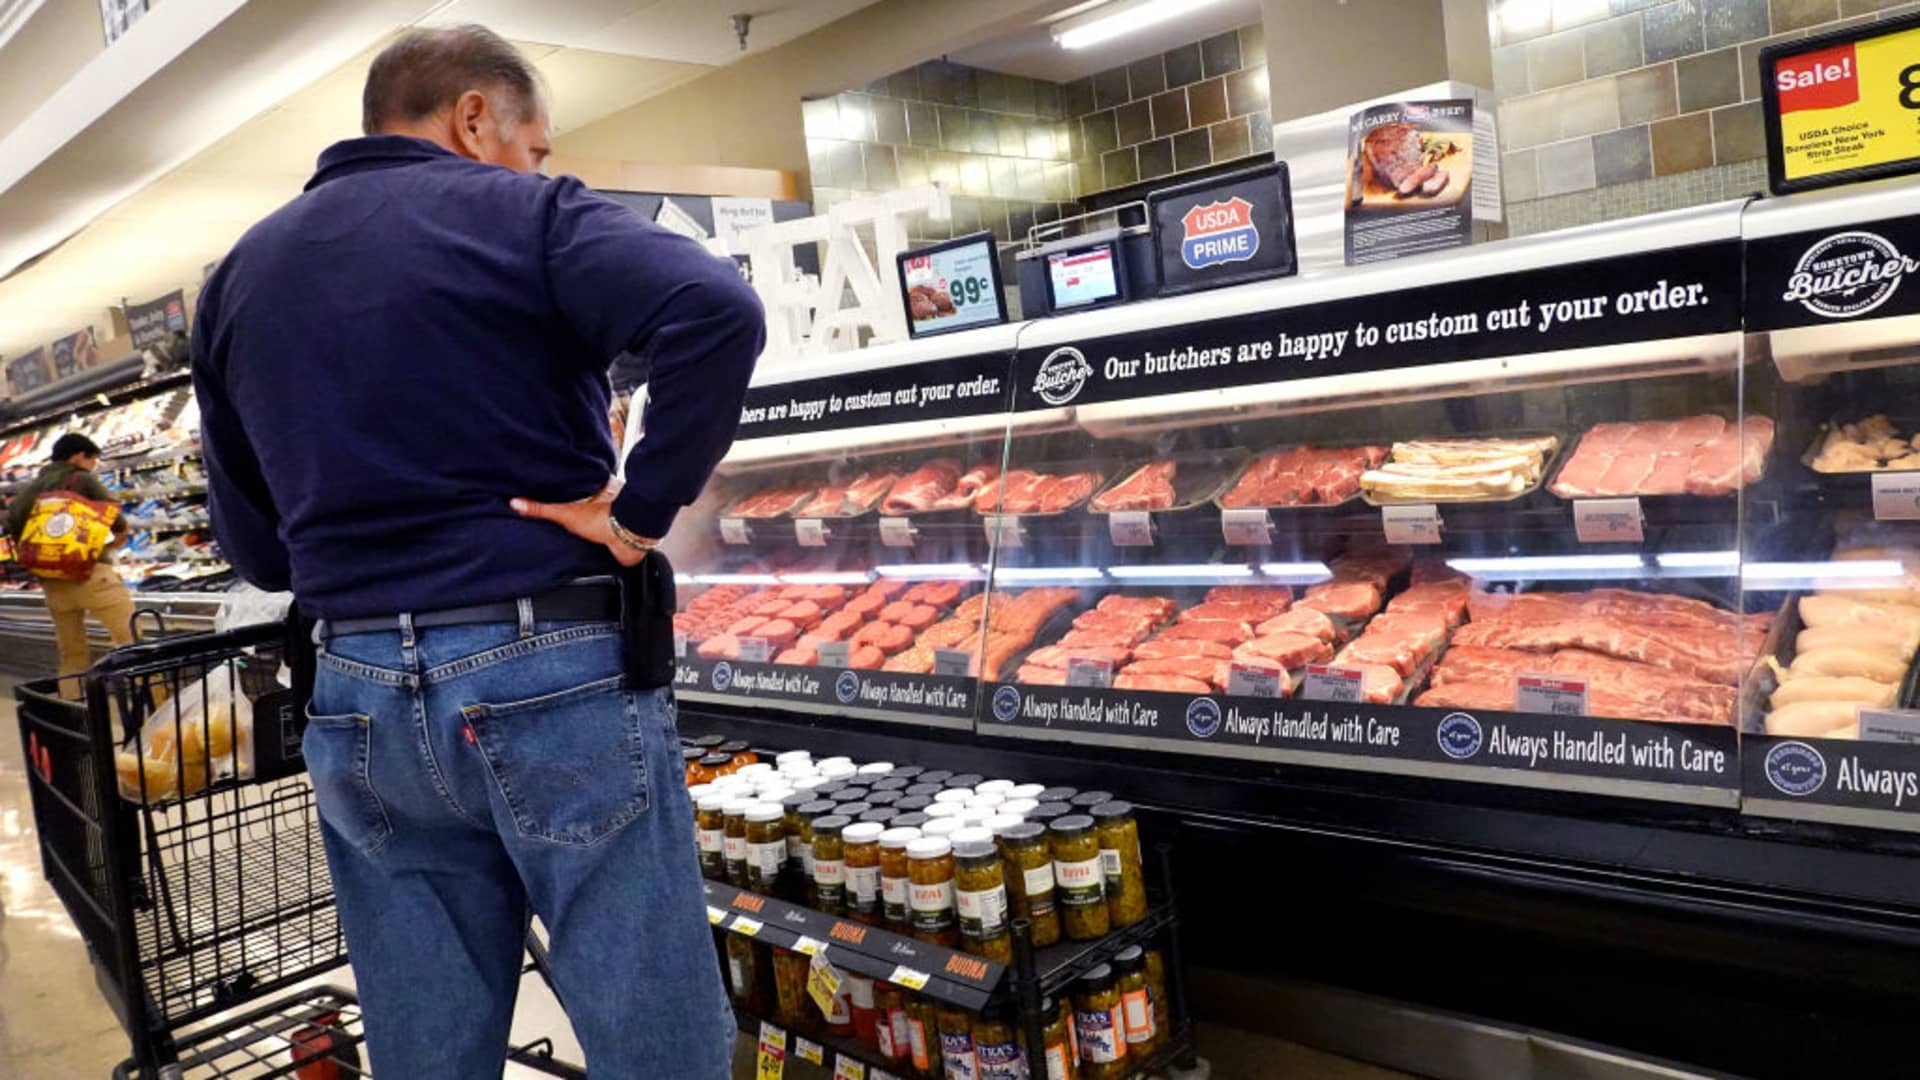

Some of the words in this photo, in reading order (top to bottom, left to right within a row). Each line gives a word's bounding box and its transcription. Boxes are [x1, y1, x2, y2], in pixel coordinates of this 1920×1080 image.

[1777, 57, 1852, 91] Sale!
[1799, 128, 1829, 141] USDA
[1832, 121, 1869, 135] Choice
[1835, 134, 1859, 145] New
[1835, 142, 1865, 155] Steak
[1195, 207, 1240, 231] USDA
[1193, 234, 1249, 260] PRIME
[1812, 250, 1876, 272] HOMETOWN
[1783, 254, 1920, 301] Butcher
[1104, 356, 1140, 380] Our
[1145, 345, 1231, 375] butchers
[1237, 340, 1272, 362] are
[1279, 330, 1349, 361] happy
[1355, 321, 1379, 348] to
[1385, 311, 1478, 343] custom
[1487, 299, 1530, 330] cut
[1539, 296, 1608, 332] your
[1616, 280, 1709, 314] order.
[740, 406, 766, 424] hers
[768, 404, 787, 422] are
[789, 398, 826, 421] happy
[830, 394, 842, 413] to
[845, 390, 891, 411] custom
[895, 384, 917, 404] cut
[921, 382, 954, 407] your
[957, 374, 1000, 397] order.
[803, 675, 820, 695] Care
[860, 678, 888, 707] Always
[889, 681, 925, 704] Handled
[925, 684, 945, 707] with
[946, 685, 967, 709] Care
[1023, 694, 1058, 726] Always
[1060, 697, 1104, 722] Handled
[1105, 699, 1130, 725] with
[1132, 701, 1159, 727] Care
[1224, 707, 1270, 744] Always
[1273, 711, 1328, 740] Handled
[1331, 715, 1363, 743] with
[1367, 717, 1400, 746] Care
[1488, 725, 1548, 768] Always
[1553, 730, 1626, 765] Handled
[1631, 739, 1674, 769] with
[1680, 739, 1725, 774] Care
[1837, 755, 1919, 807] Always
[945, 953, 989, 981] BUONA
